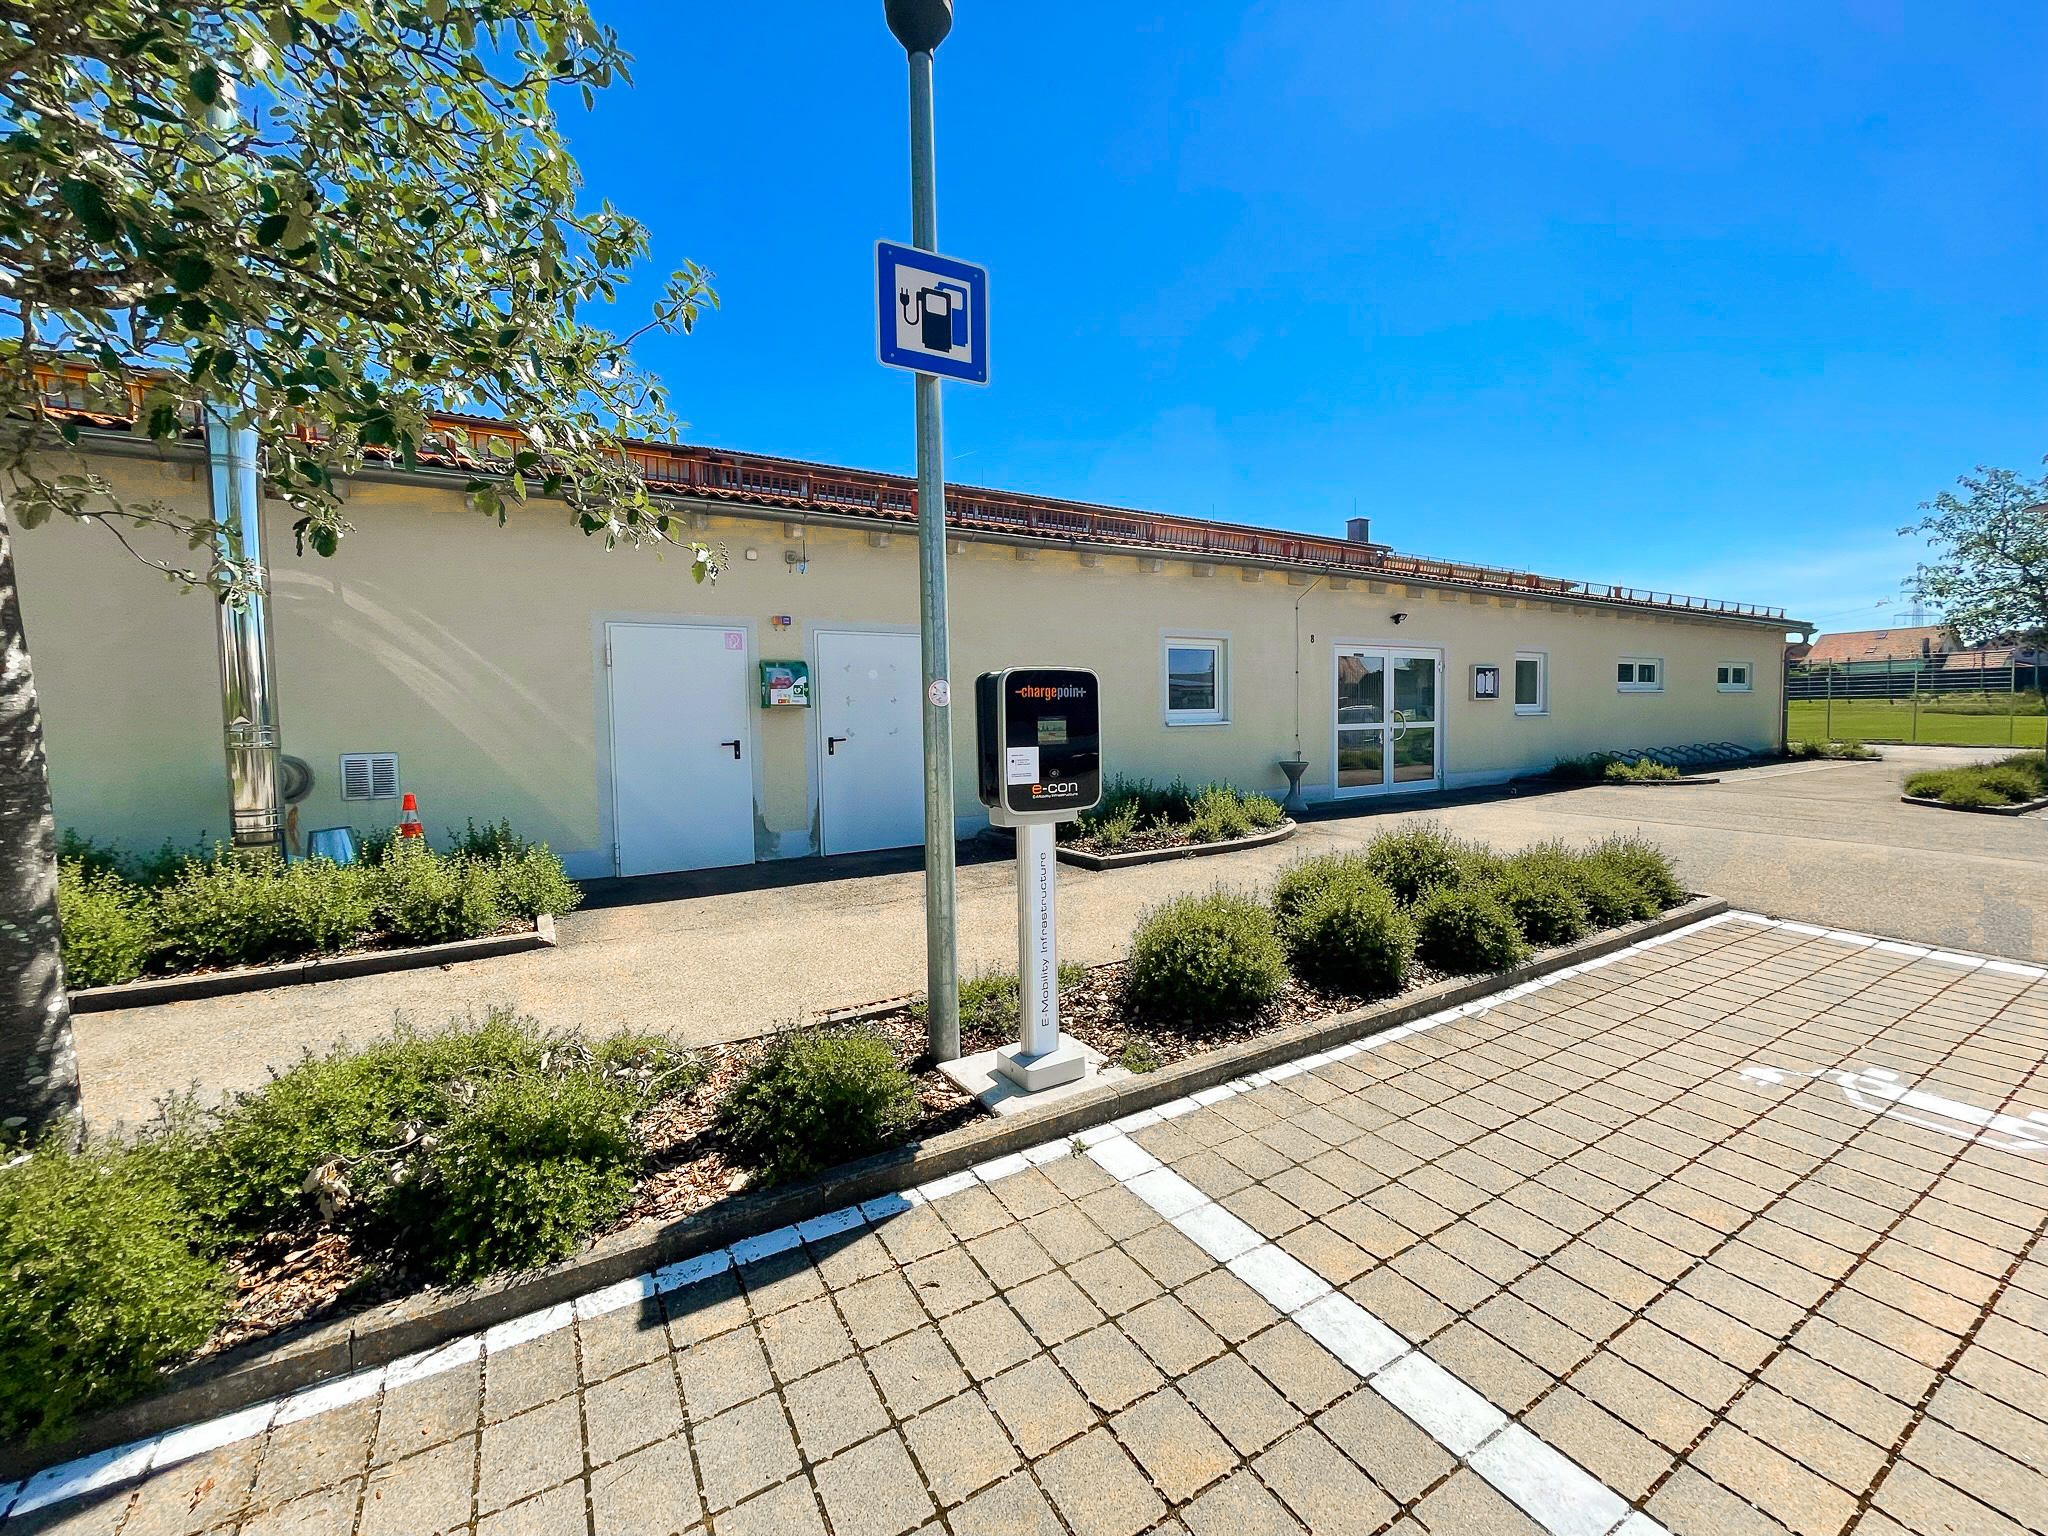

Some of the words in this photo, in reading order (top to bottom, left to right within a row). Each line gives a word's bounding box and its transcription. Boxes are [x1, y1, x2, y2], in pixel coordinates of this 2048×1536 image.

[1311, 634, 1315, 643] 8
[1032, 782, 1078, 795] e-con
[1040, 852, 1048, 953] Infrastructure
[1041, 958, 1050, 1028] E-Mobility
